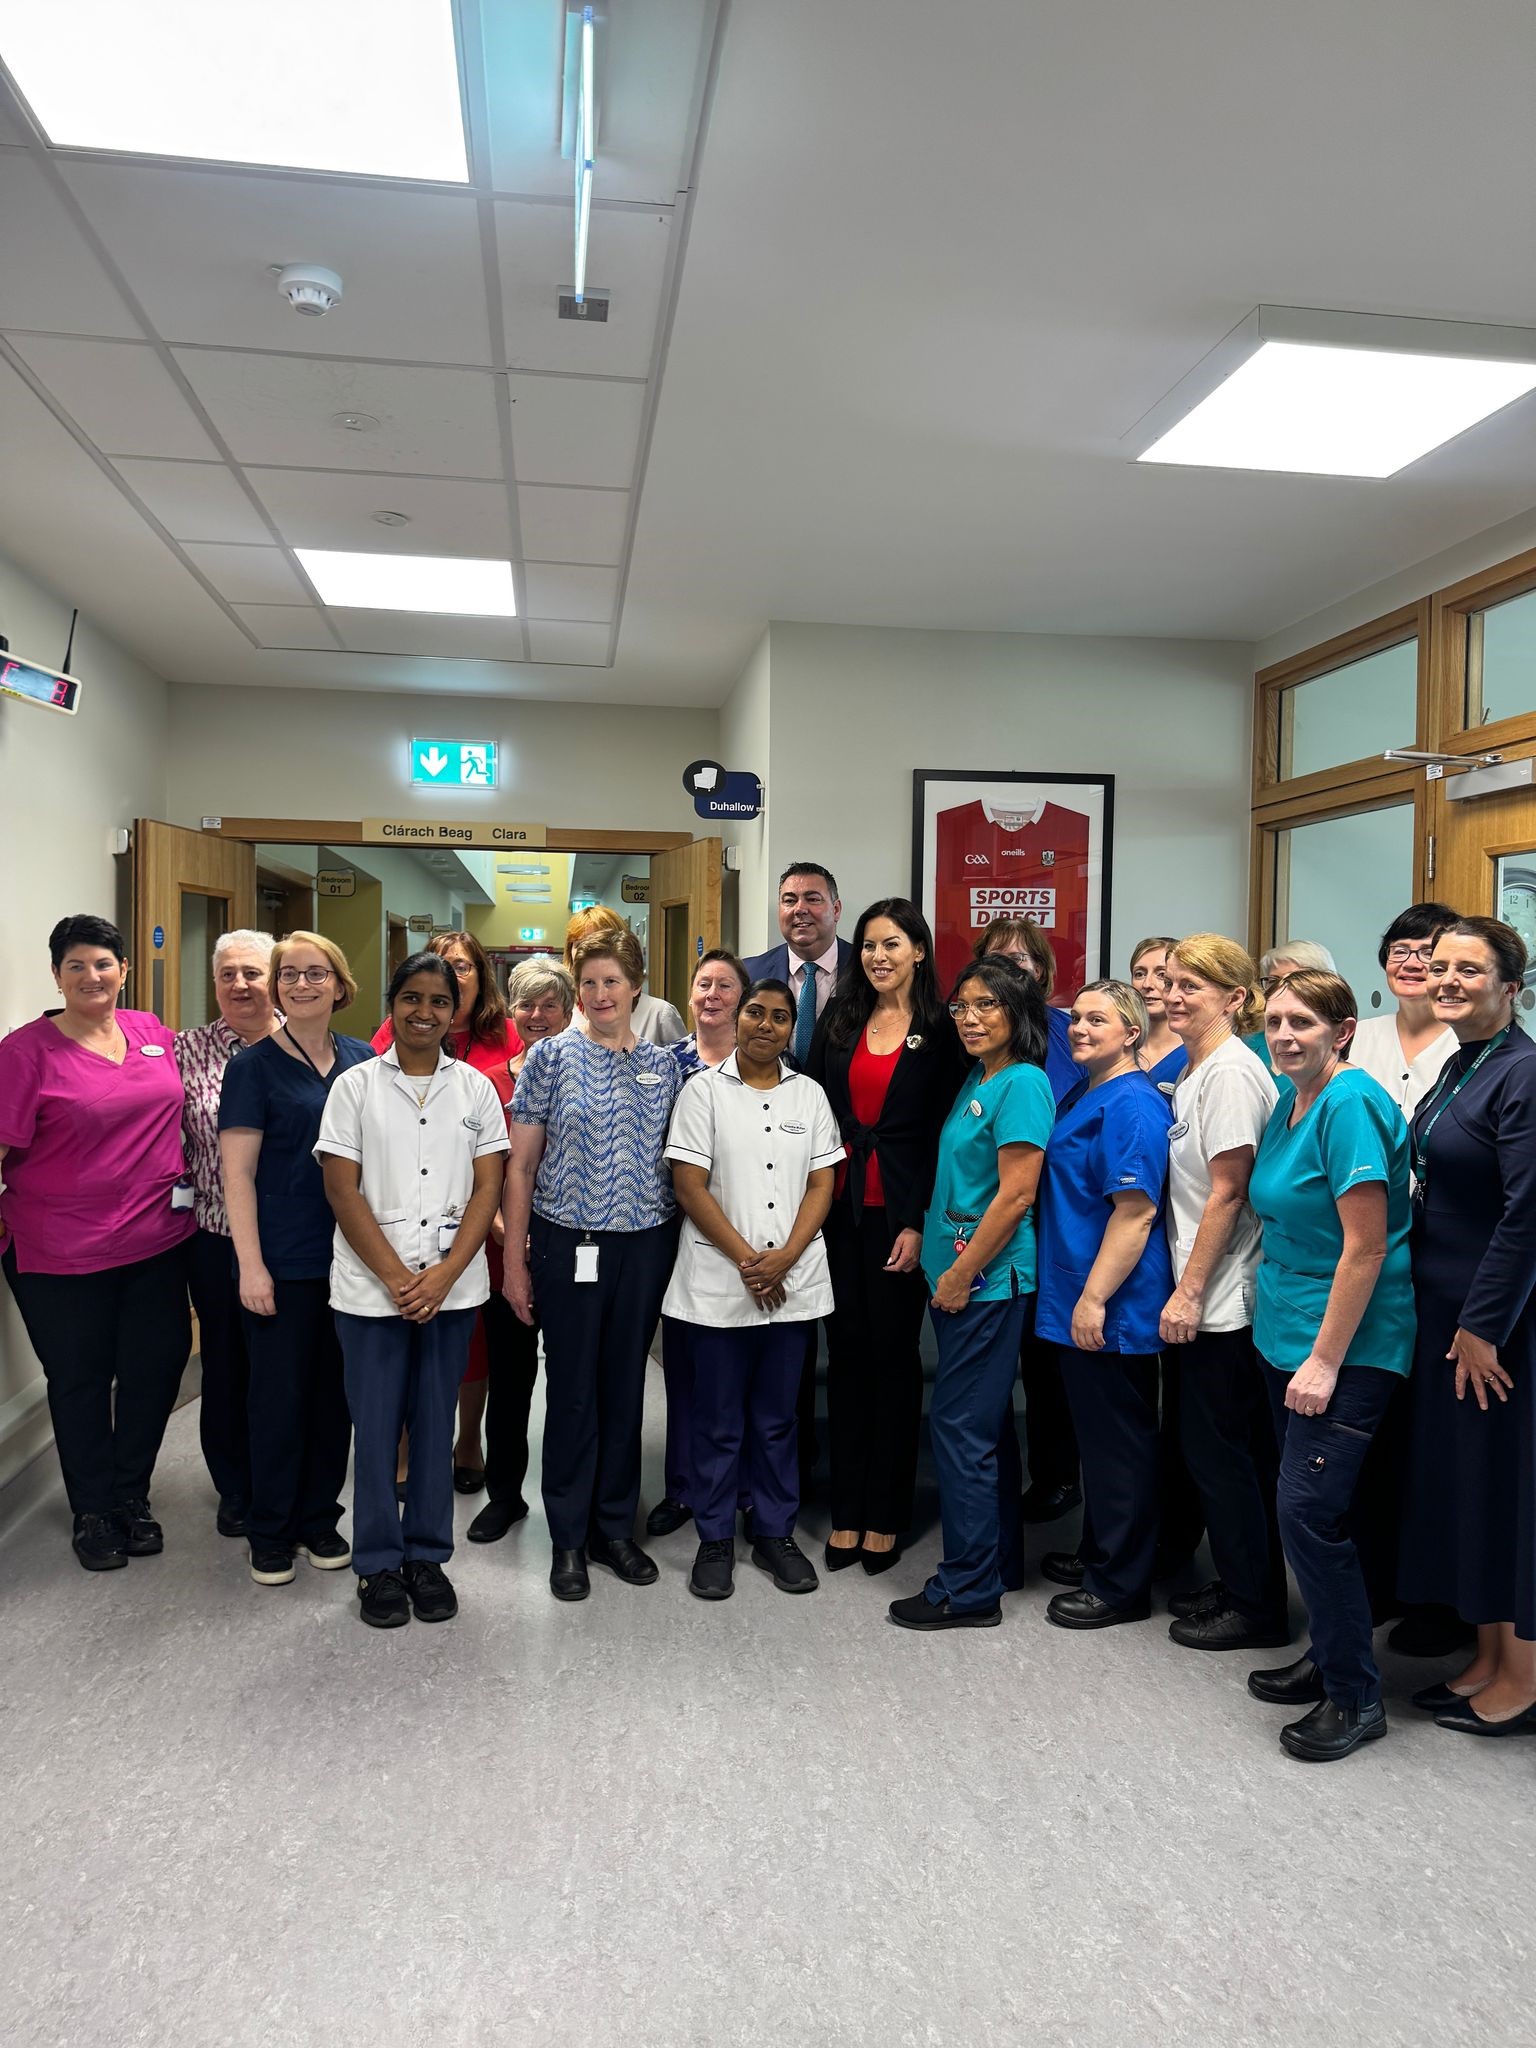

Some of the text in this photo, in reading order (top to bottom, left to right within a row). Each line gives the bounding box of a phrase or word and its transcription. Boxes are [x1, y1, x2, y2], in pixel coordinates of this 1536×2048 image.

[710, 801, 755, 812] Duhallow
[382, 824, 527, 841] Clárach Beag Clara
[1001, 848, 1026, 857] oneills
[321, 876, 350, 884] Bedroom
[330, 885, 341, 894] 01
[633, 892, 645, 901] 02
[975, 889, 1051, 905] SPORTS
[1509, 894, 1519, 905] 12
